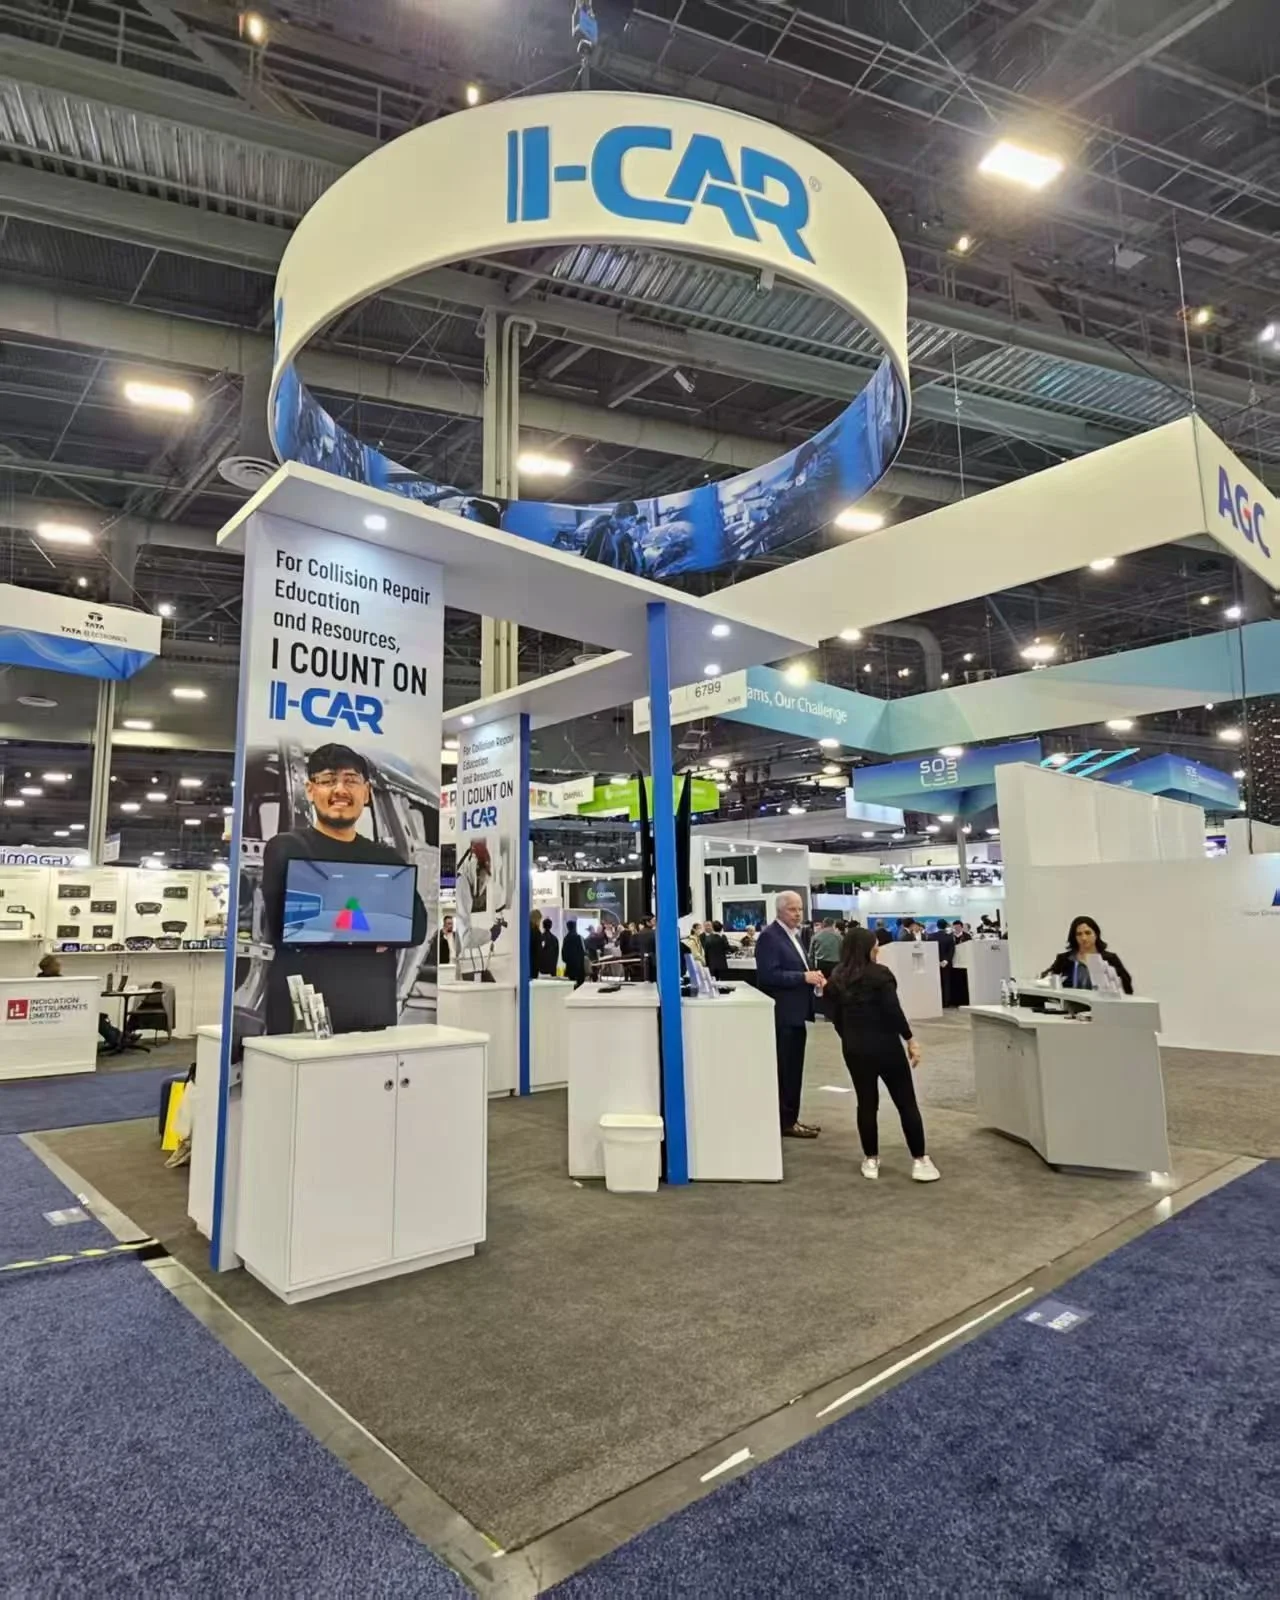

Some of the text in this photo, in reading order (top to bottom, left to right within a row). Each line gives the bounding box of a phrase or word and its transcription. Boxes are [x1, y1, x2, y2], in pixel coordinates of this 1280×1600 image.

[1218, 464, 1271, 559] AGC
[276, 549, 431, 605] For Collision Repair
[275, 578, 360, 616] Education
[61, 625, 82, 634] TATA
[84, 621, 105, 630] TATA
[273, 611, 401, 654] and Resources,
[272, 637, 427, 697] I COUNT ON
[694, 680, 722, 698] 6799
[775, 690, 796, 710] Our
[798, 697, 848, 725] Challenge
[463, 756, 489, 771] Education
[467, 783, 498, 805] COUNT
[500, 779, 514, 799] ON
[462, 806, 497, 831] I-CAR
[31, 1003, 88, 1012] INSTRUMENTS
